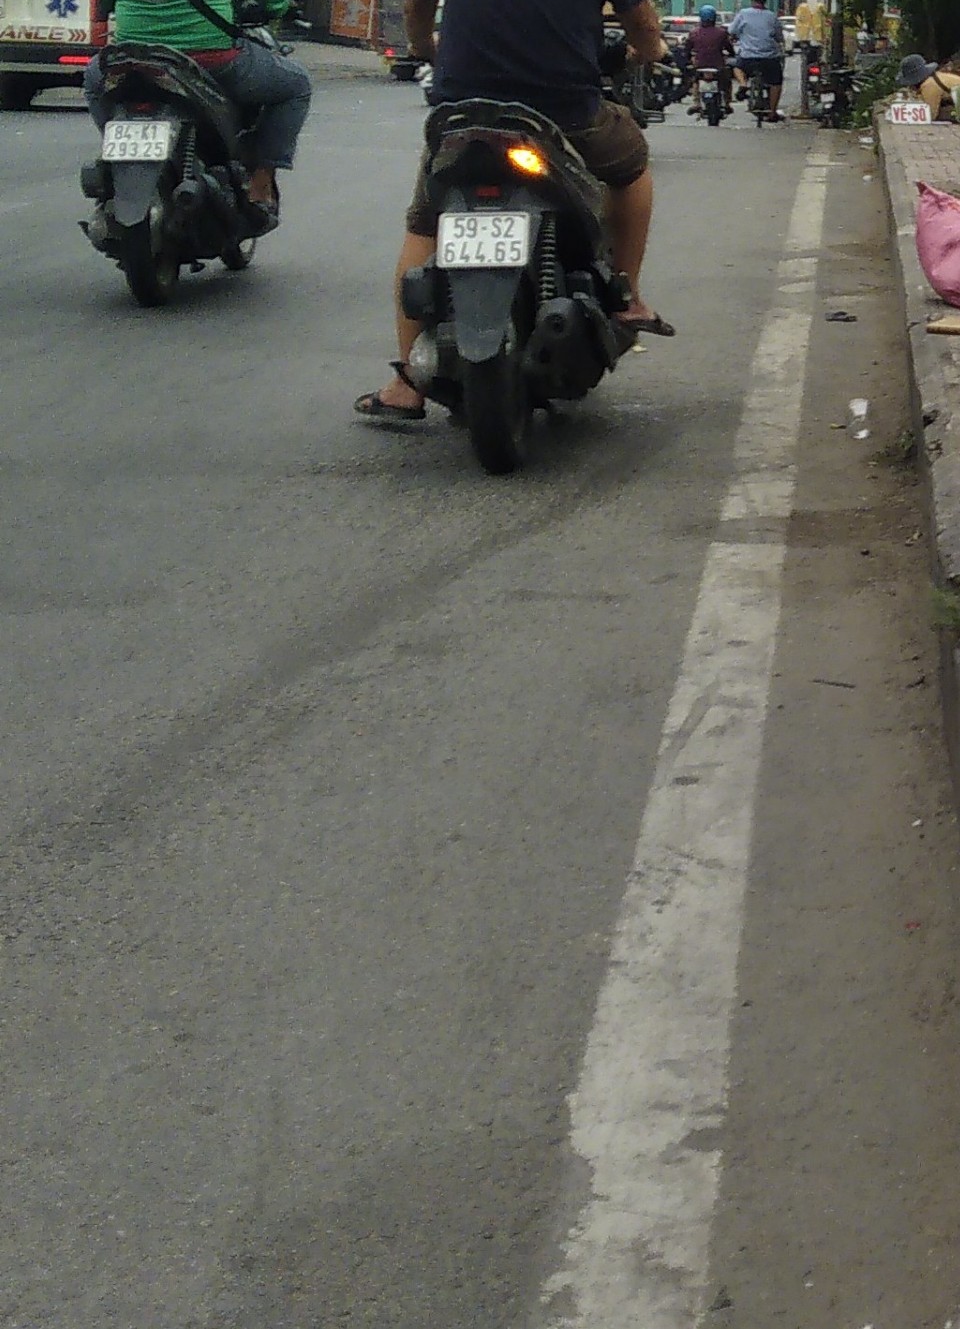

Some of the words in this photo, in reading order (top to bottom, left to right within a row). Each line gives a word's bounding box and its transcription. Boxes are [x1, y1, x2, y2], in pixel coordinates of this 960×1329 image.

[114, 124, 158, 141] 84-K1
[453, 217, 516, 239] 59-S2
[444, 240, 522, 263] 644.65
